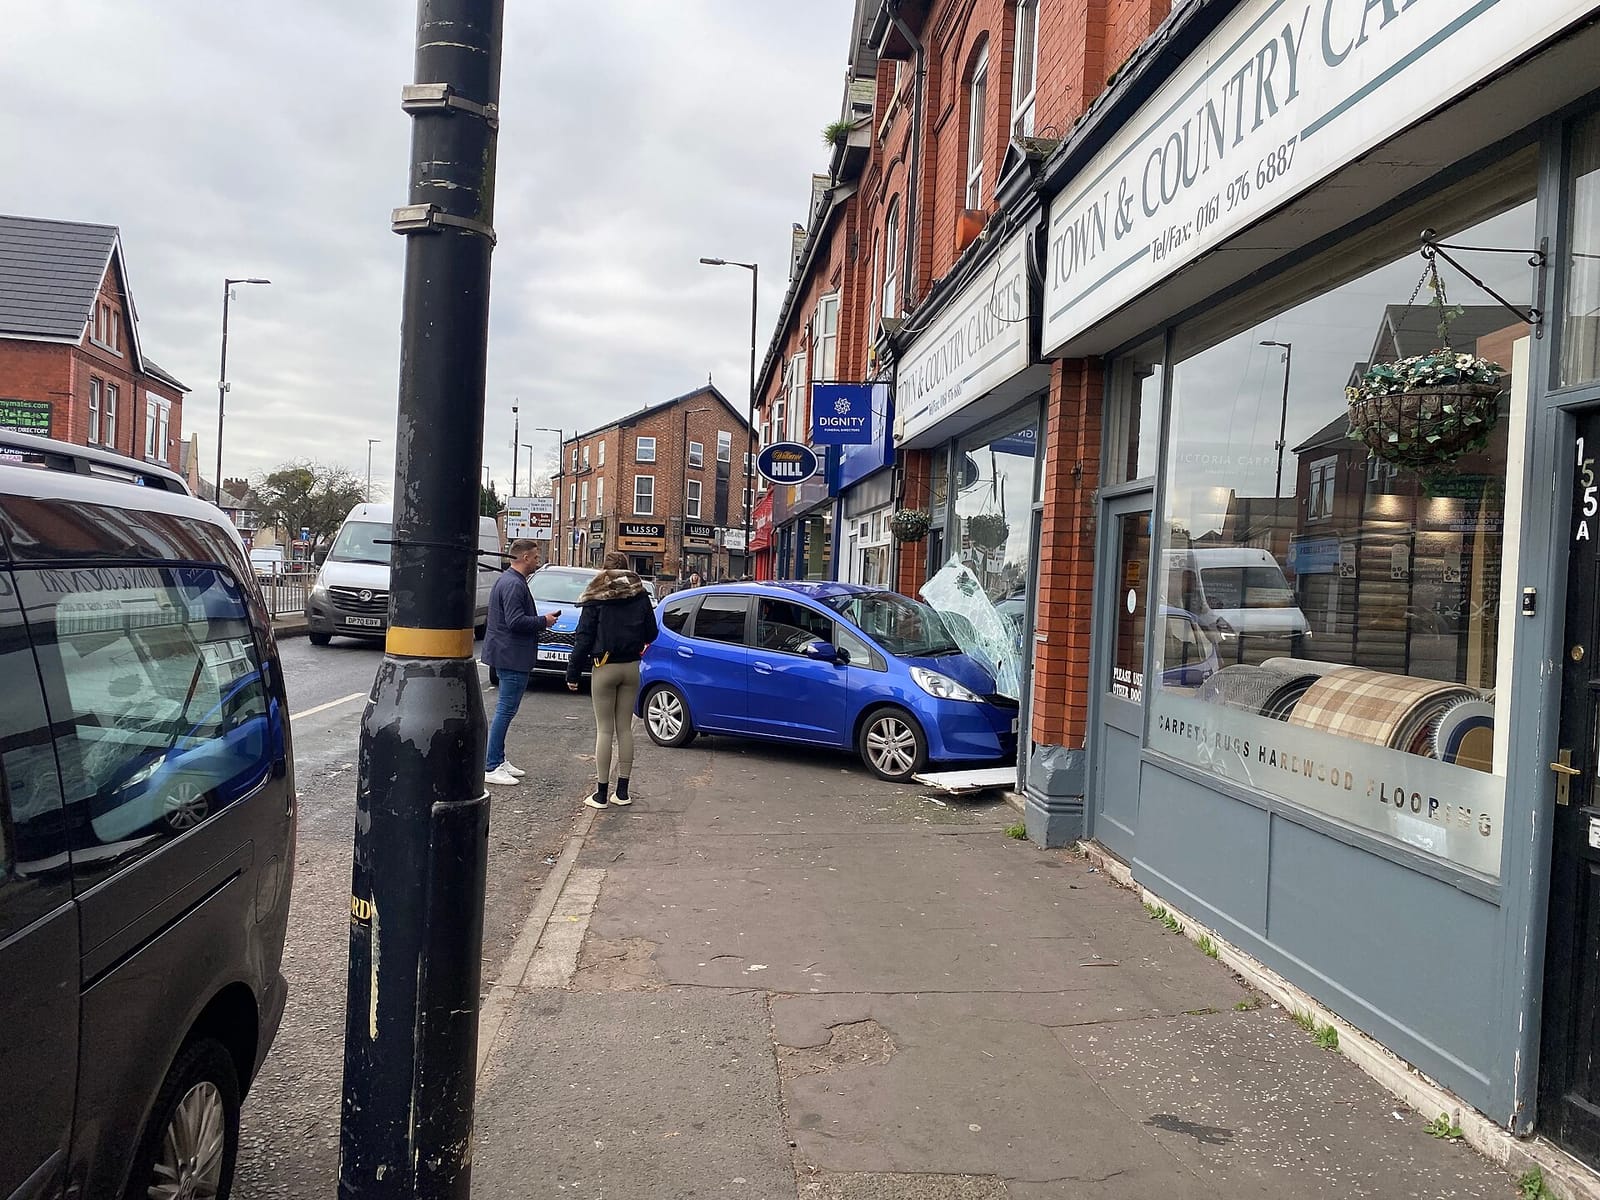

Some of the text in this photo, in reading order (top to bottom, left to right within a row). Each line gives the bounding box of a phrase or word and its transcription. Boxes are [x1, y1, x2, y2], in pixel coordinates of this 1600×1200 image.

[1052, 0, 1418, 292] TOWN & COUNTRY CA
[1151, 135, 1298, 264] Tel/Fax: 0161 976 6887
[925, 330, 967, 394] COUNTRY
[968, 273, 1021, 357] CARPETS
[819, 417, 865, 427] DIGNITY
[771, 461, 803, 476] HILL
[626, 525, 659, 534] LUSSO
[690, 526, 710, 534] LUSSO
[557, 652, 570, 661] LL
[1113, 666, 1144, 687] PLEASE USE
[1112, 682, 1142, 702] OTHER DOO
[1158, 714, 1208, 742] CARPETS
[1215, 731, 1250, 758] RUGS
